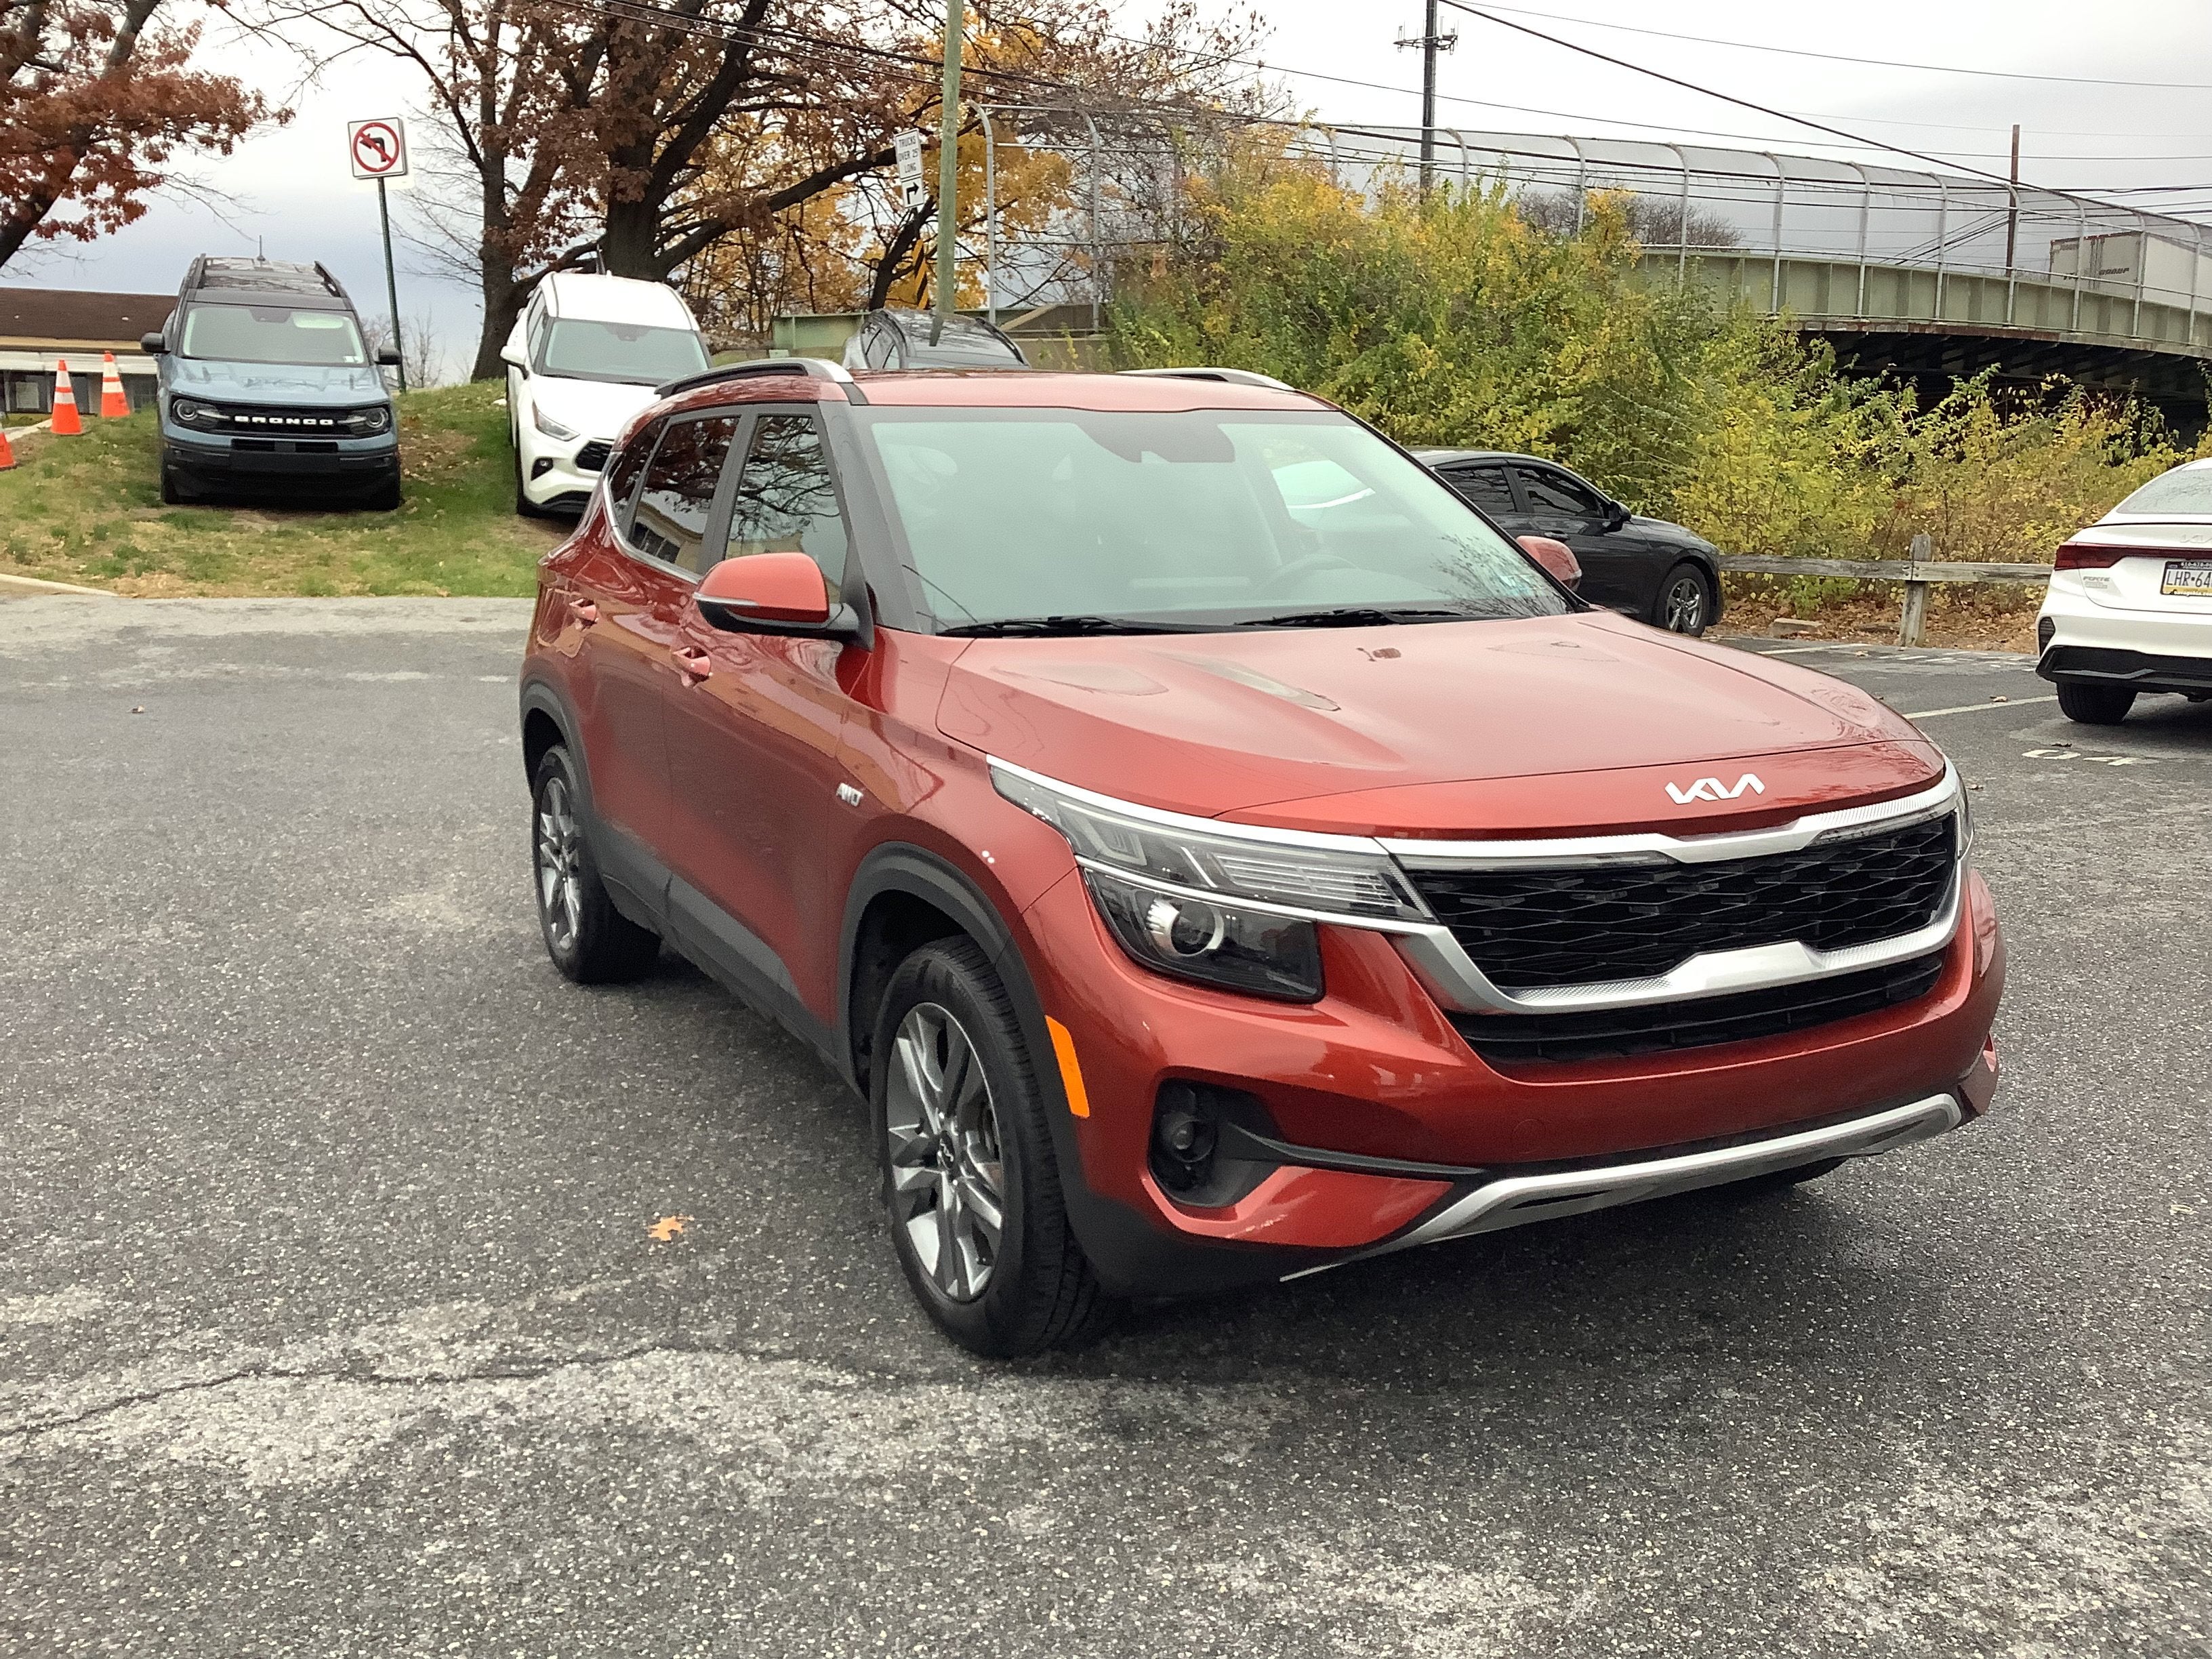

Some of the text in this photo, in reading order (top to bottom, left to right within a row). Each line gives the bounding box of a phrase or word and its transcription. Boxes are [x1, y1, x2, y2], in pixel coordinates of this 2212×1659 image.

[899, 136, 916, 148] TRUCKS
[899, 150, 911, 162] OVER
[905, 163, 917, 173] LONG
[234, 415, 334, 426] BRONCO
[2166, 571, 2212, 588] LHR-64
[1664, 773, 1765, 805] KIA
